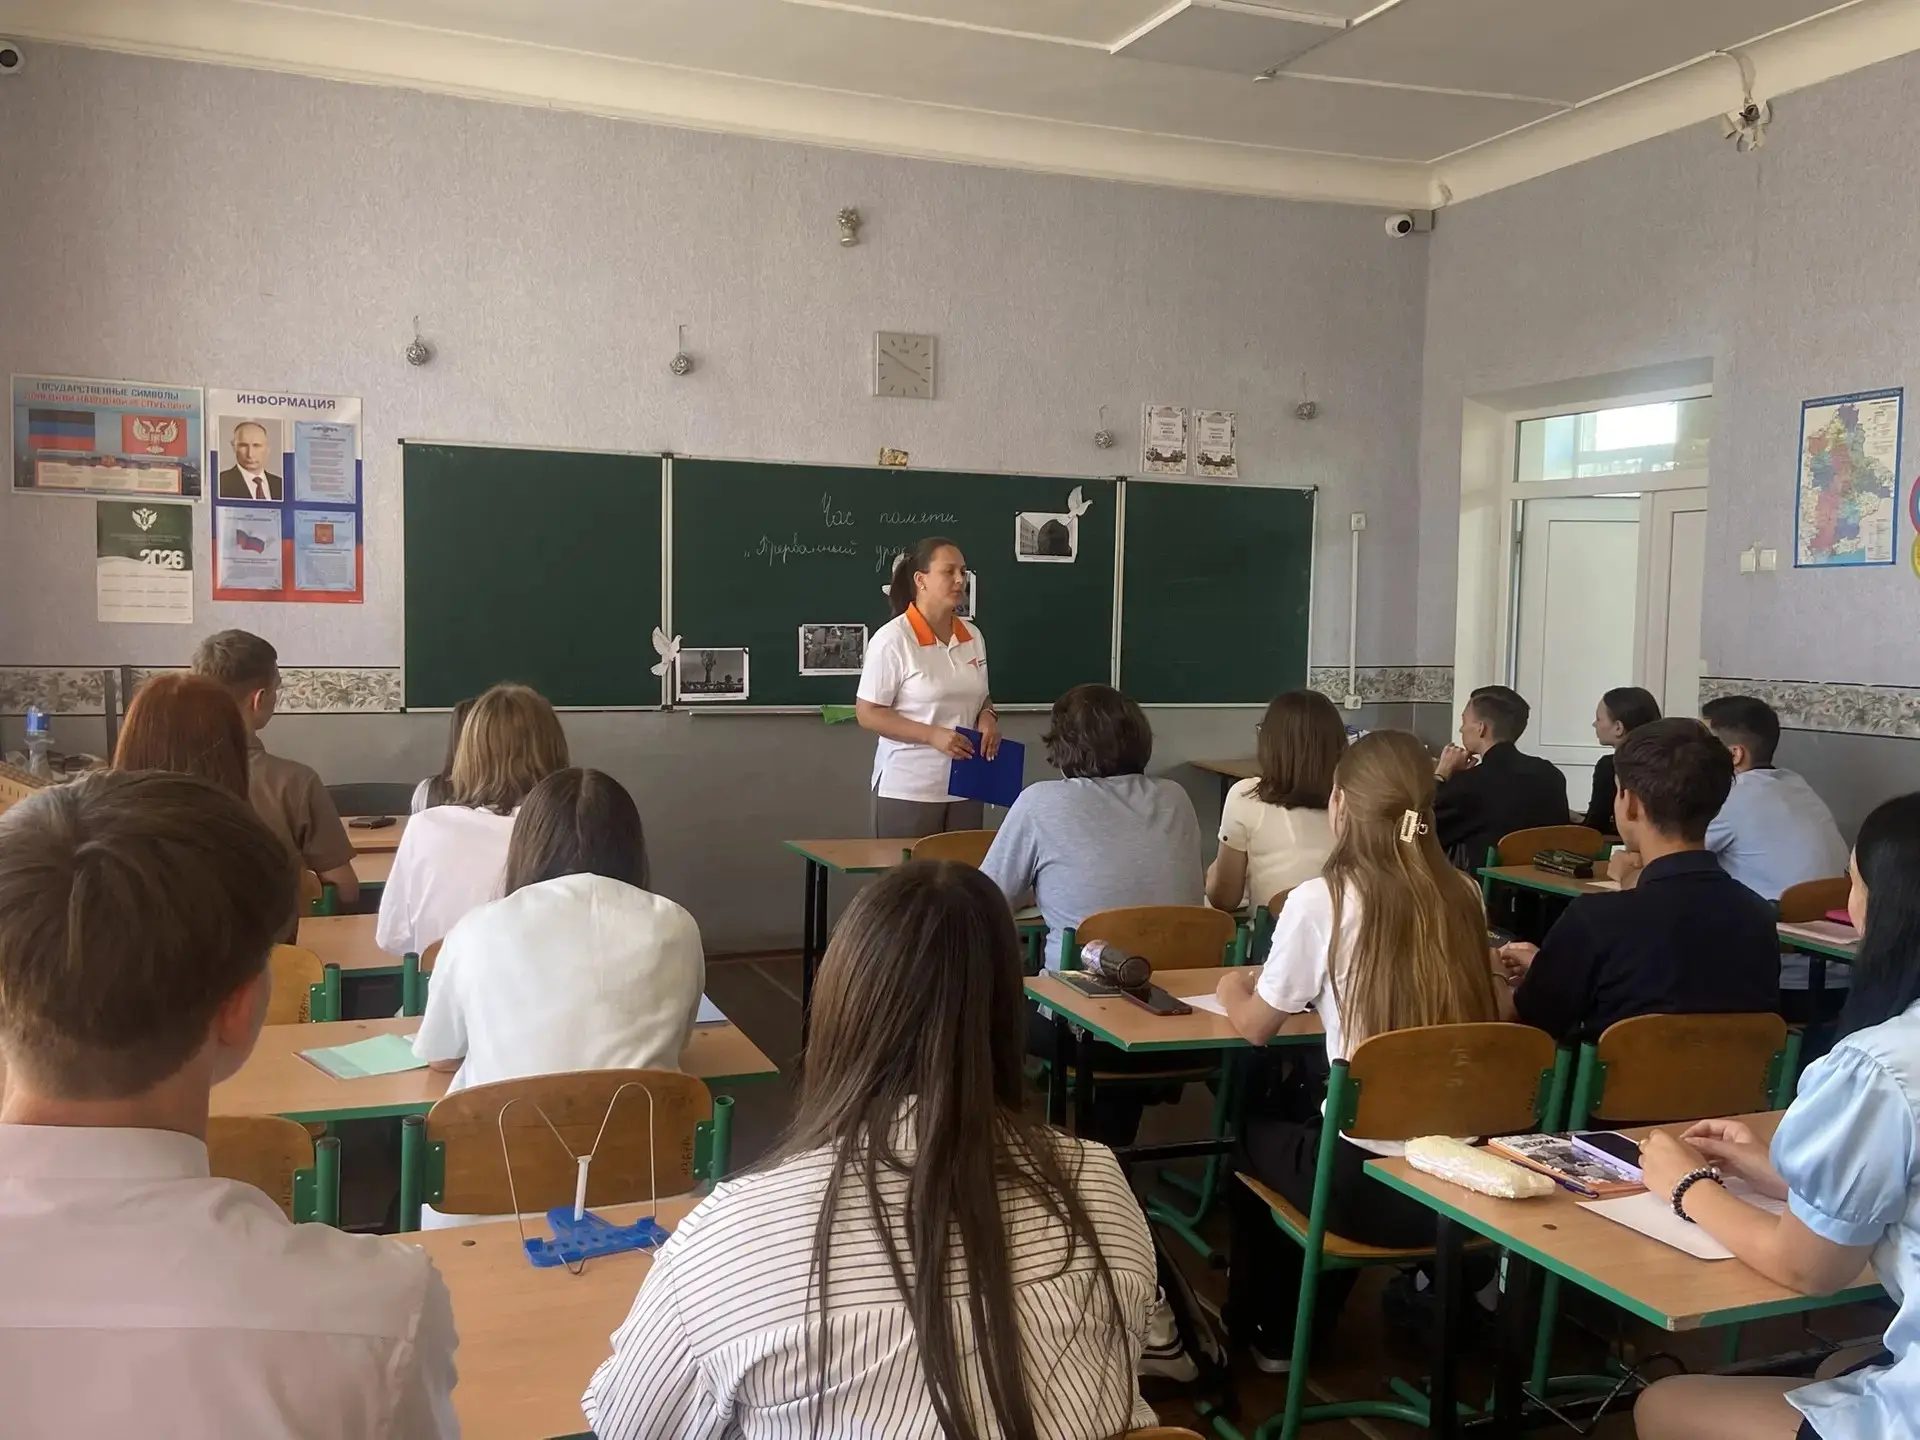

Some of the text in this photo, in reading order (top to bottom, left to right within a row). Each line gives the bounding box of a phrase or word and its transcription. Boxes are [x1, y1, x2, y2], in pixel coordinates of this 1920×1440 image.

[36, 382, 179, 400] ГОСУДАРСТВЕННЫЕ СИМВОЛЫ
[237, 393, 336, 410] ИНФОРМАЦИЯ
[821, 491, 959, 528] Час памяти
[140, 548, 185, 570] 2026
